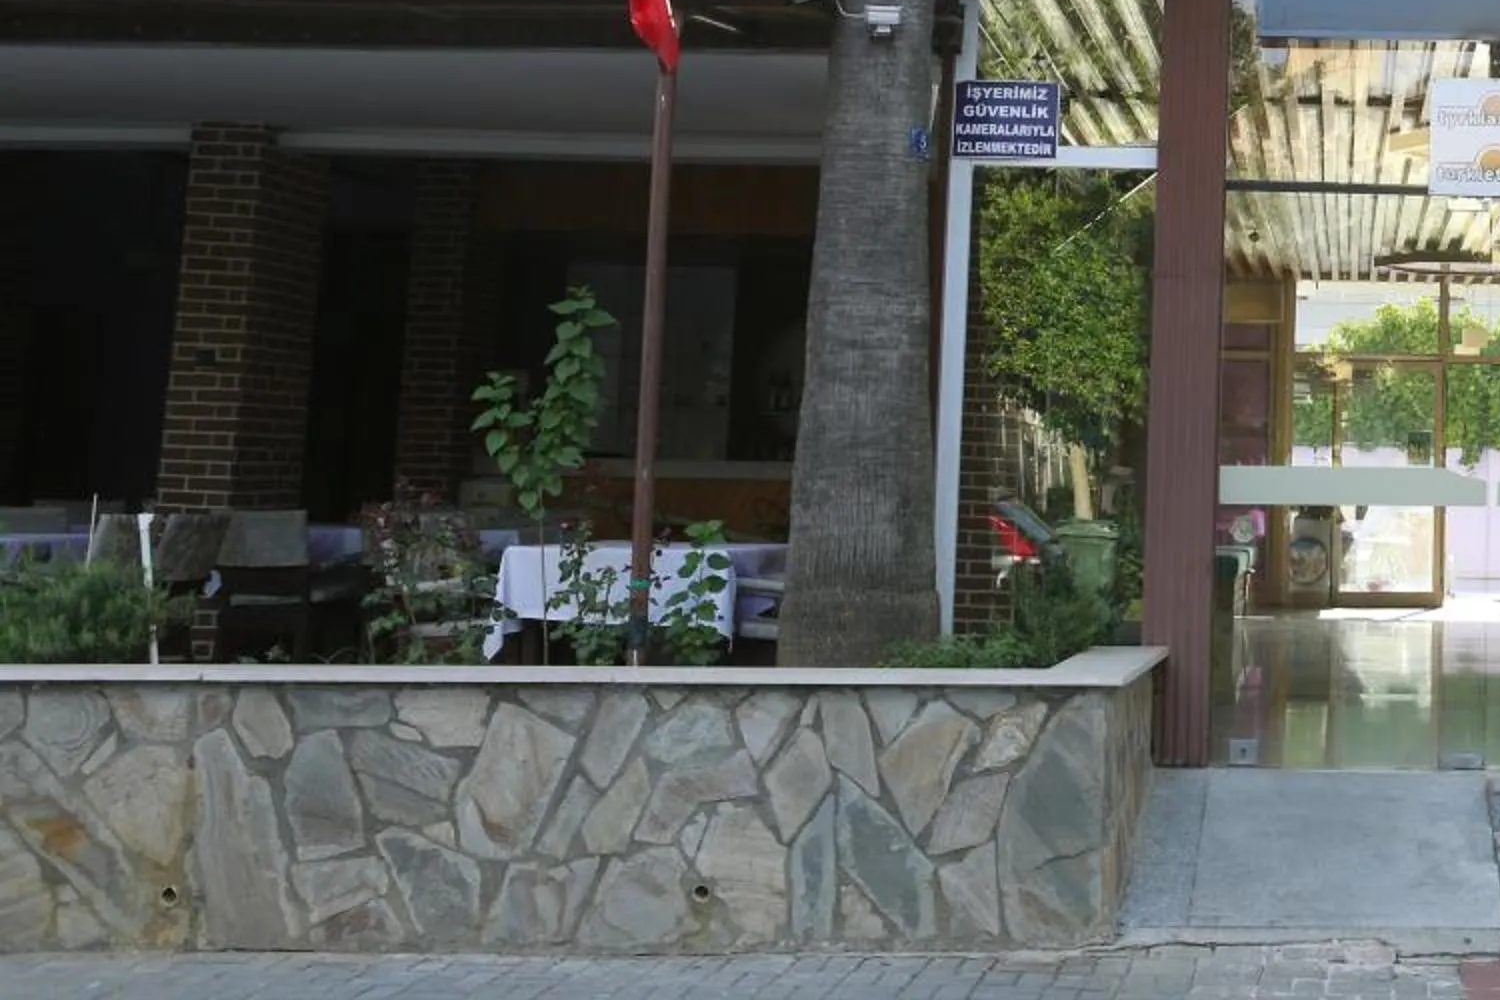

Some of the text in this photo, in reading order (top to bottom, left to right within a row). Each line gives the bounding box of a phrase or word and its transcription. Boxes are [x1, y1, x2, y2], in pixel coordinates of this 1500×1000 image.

[967, 85, 1048, 101] İŞYERİMİZ
[963, 104, 1049, 118] GÜVENLİK
[955, 123, 1054, 137] KAMERALARIYLA
[957, 140, 1052, 155] İZLENMEKTEDİR
